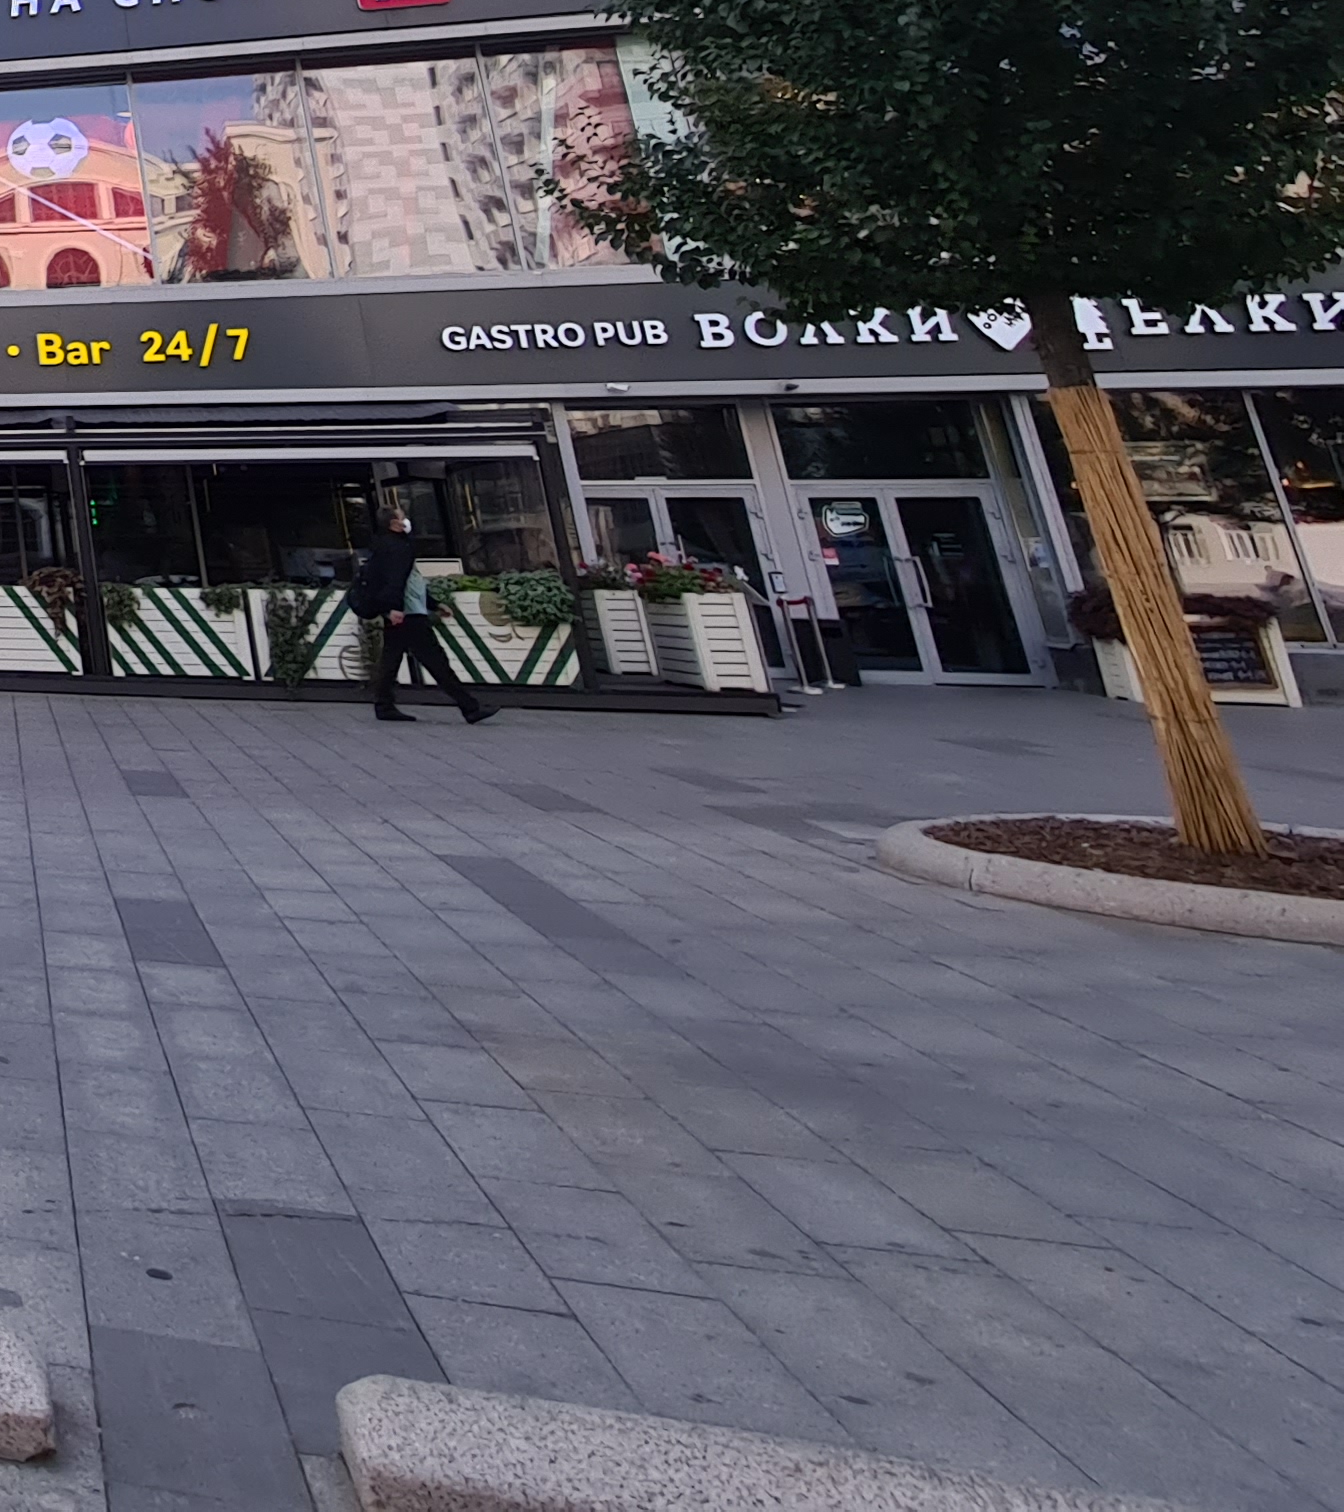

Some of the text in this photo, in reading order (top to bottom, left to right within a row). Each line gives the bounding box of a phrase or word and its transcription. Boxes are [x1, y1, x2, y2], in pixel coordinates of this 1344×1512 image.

[35, 332, 111, 367] Bar
[139, 323, 250, 368] 24/7
[441, 320, 669, 351] GASTRO PUB
